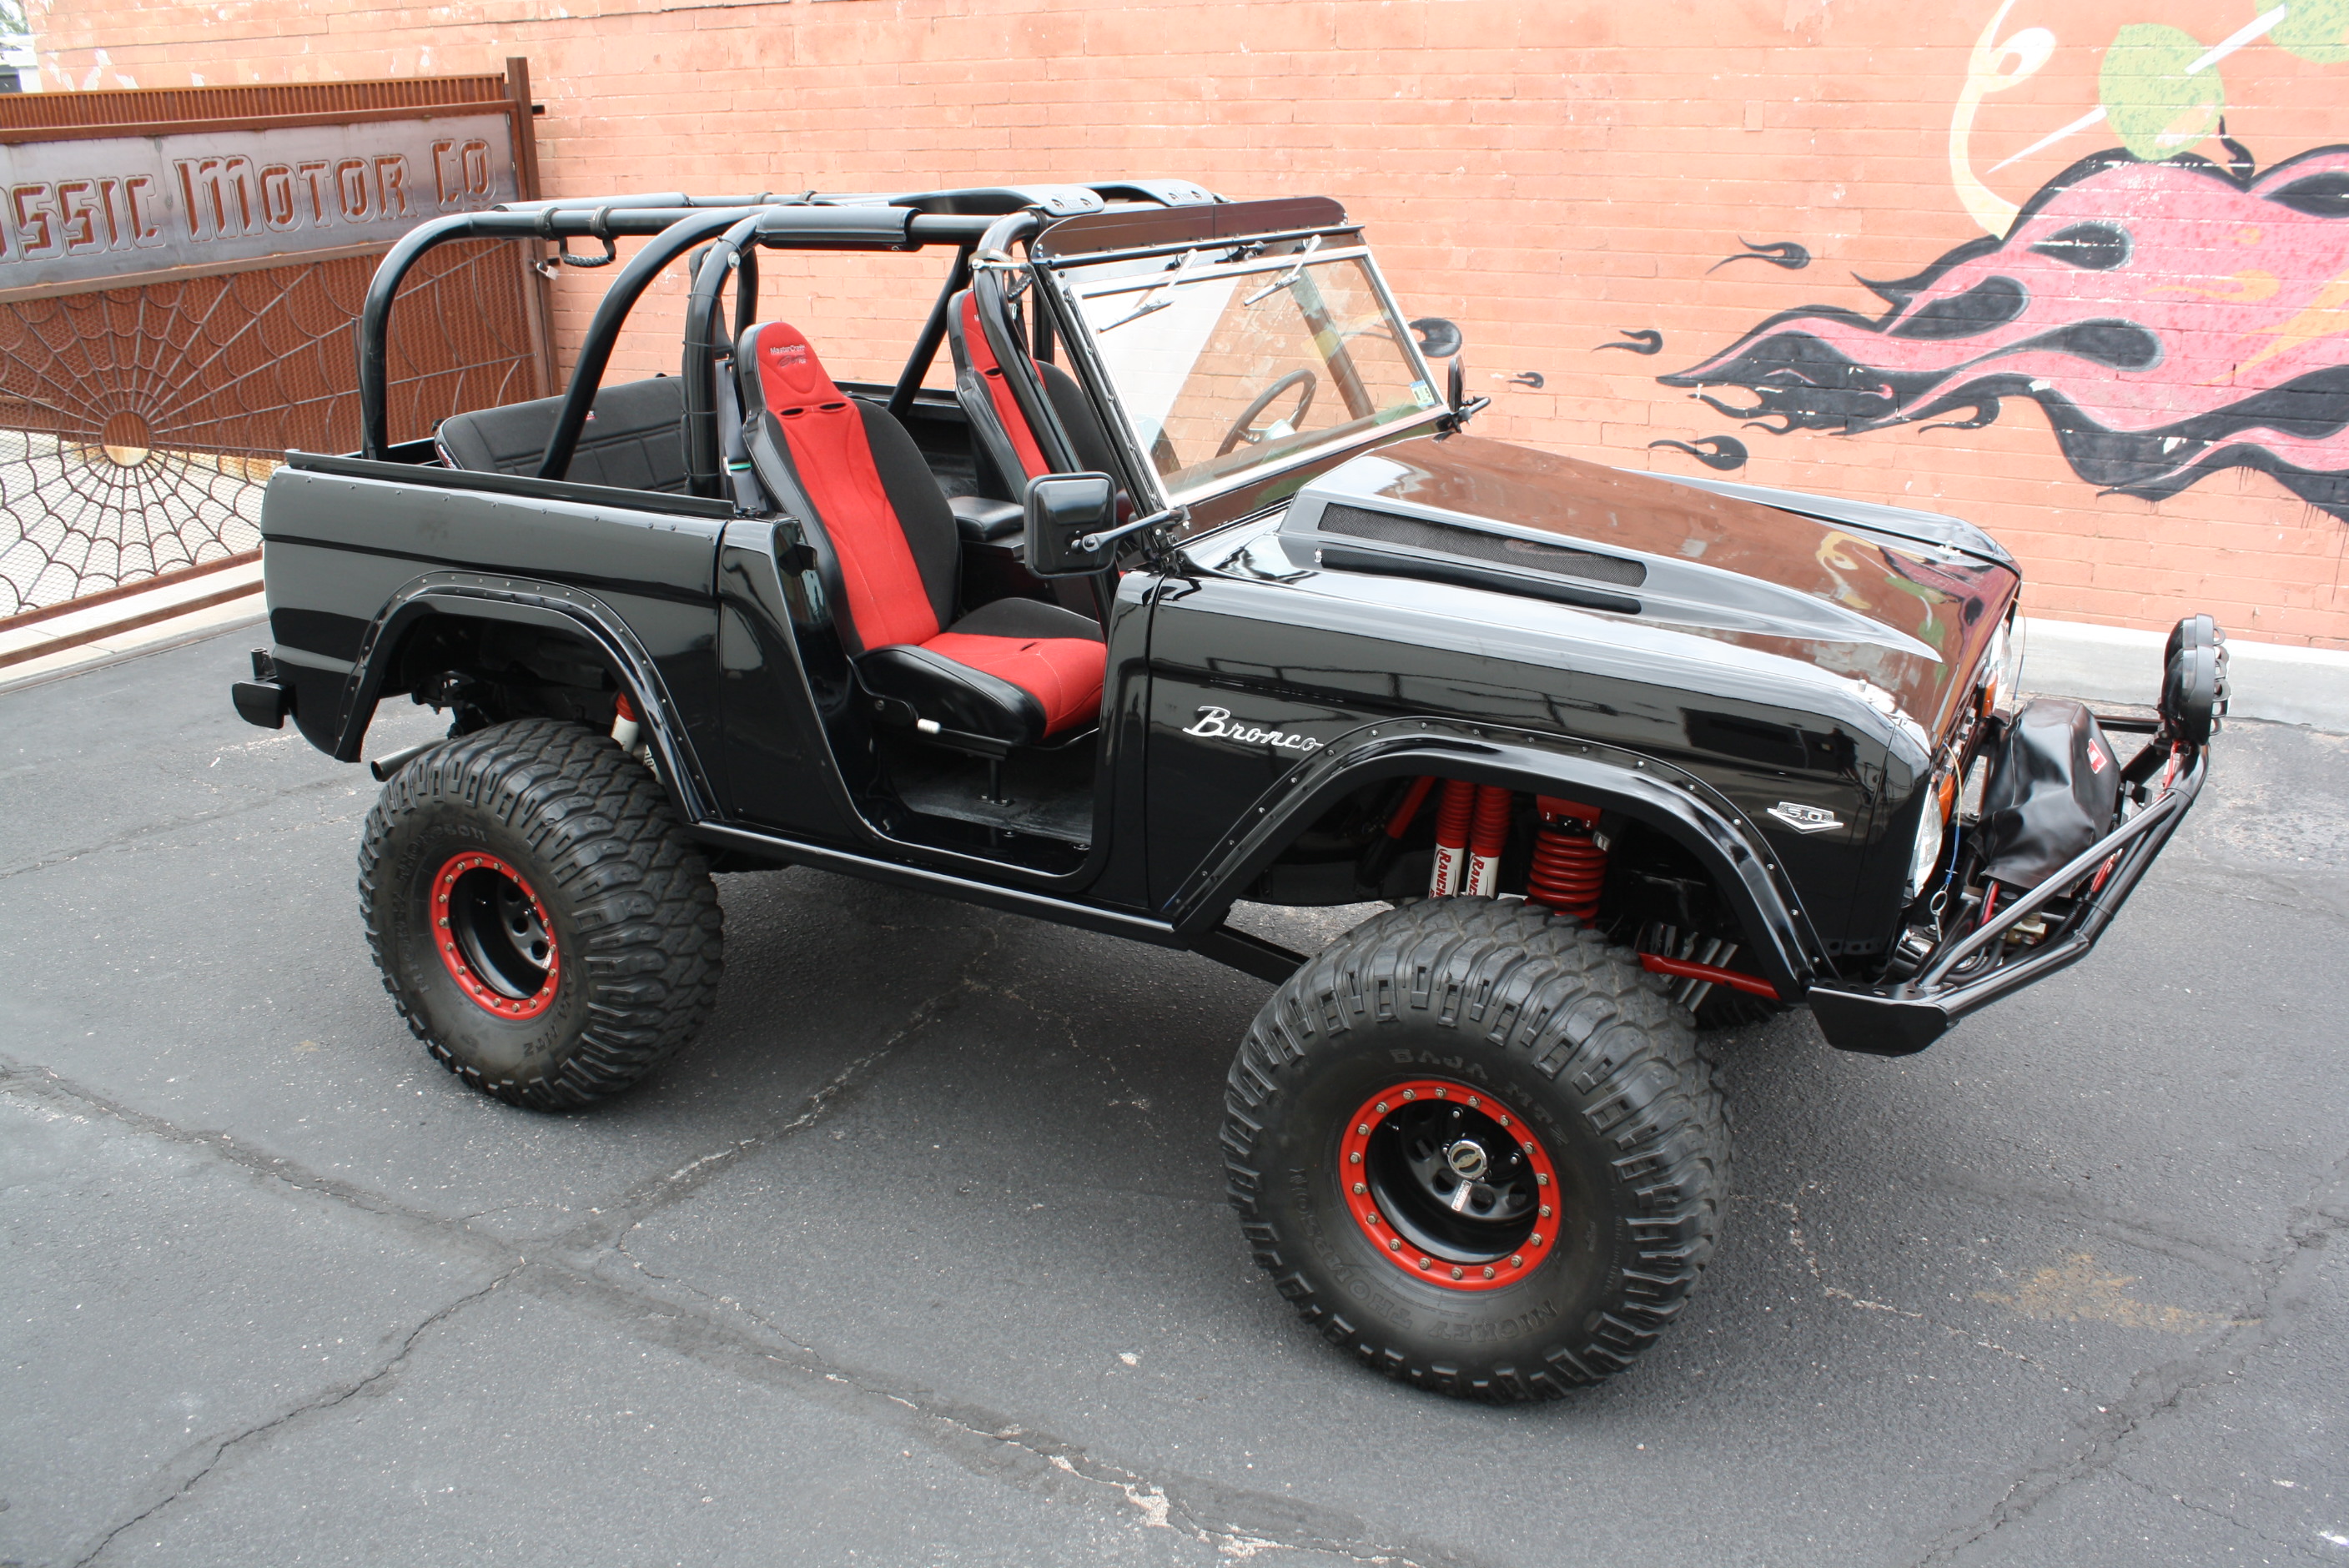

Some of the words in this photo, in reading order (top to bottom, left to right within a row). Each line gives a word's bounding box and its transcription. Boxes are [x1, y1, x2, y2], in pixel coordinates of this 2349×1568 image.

[173, 153, 419, 243] MOTOR
[1182, 706, 1325, 751] Bronco
[1786, 807, 1823, 822] 5.0
[1388, 1048, 1489, 1081] BAJA
[1427, 1299, 1559, 1344] MICKEY
